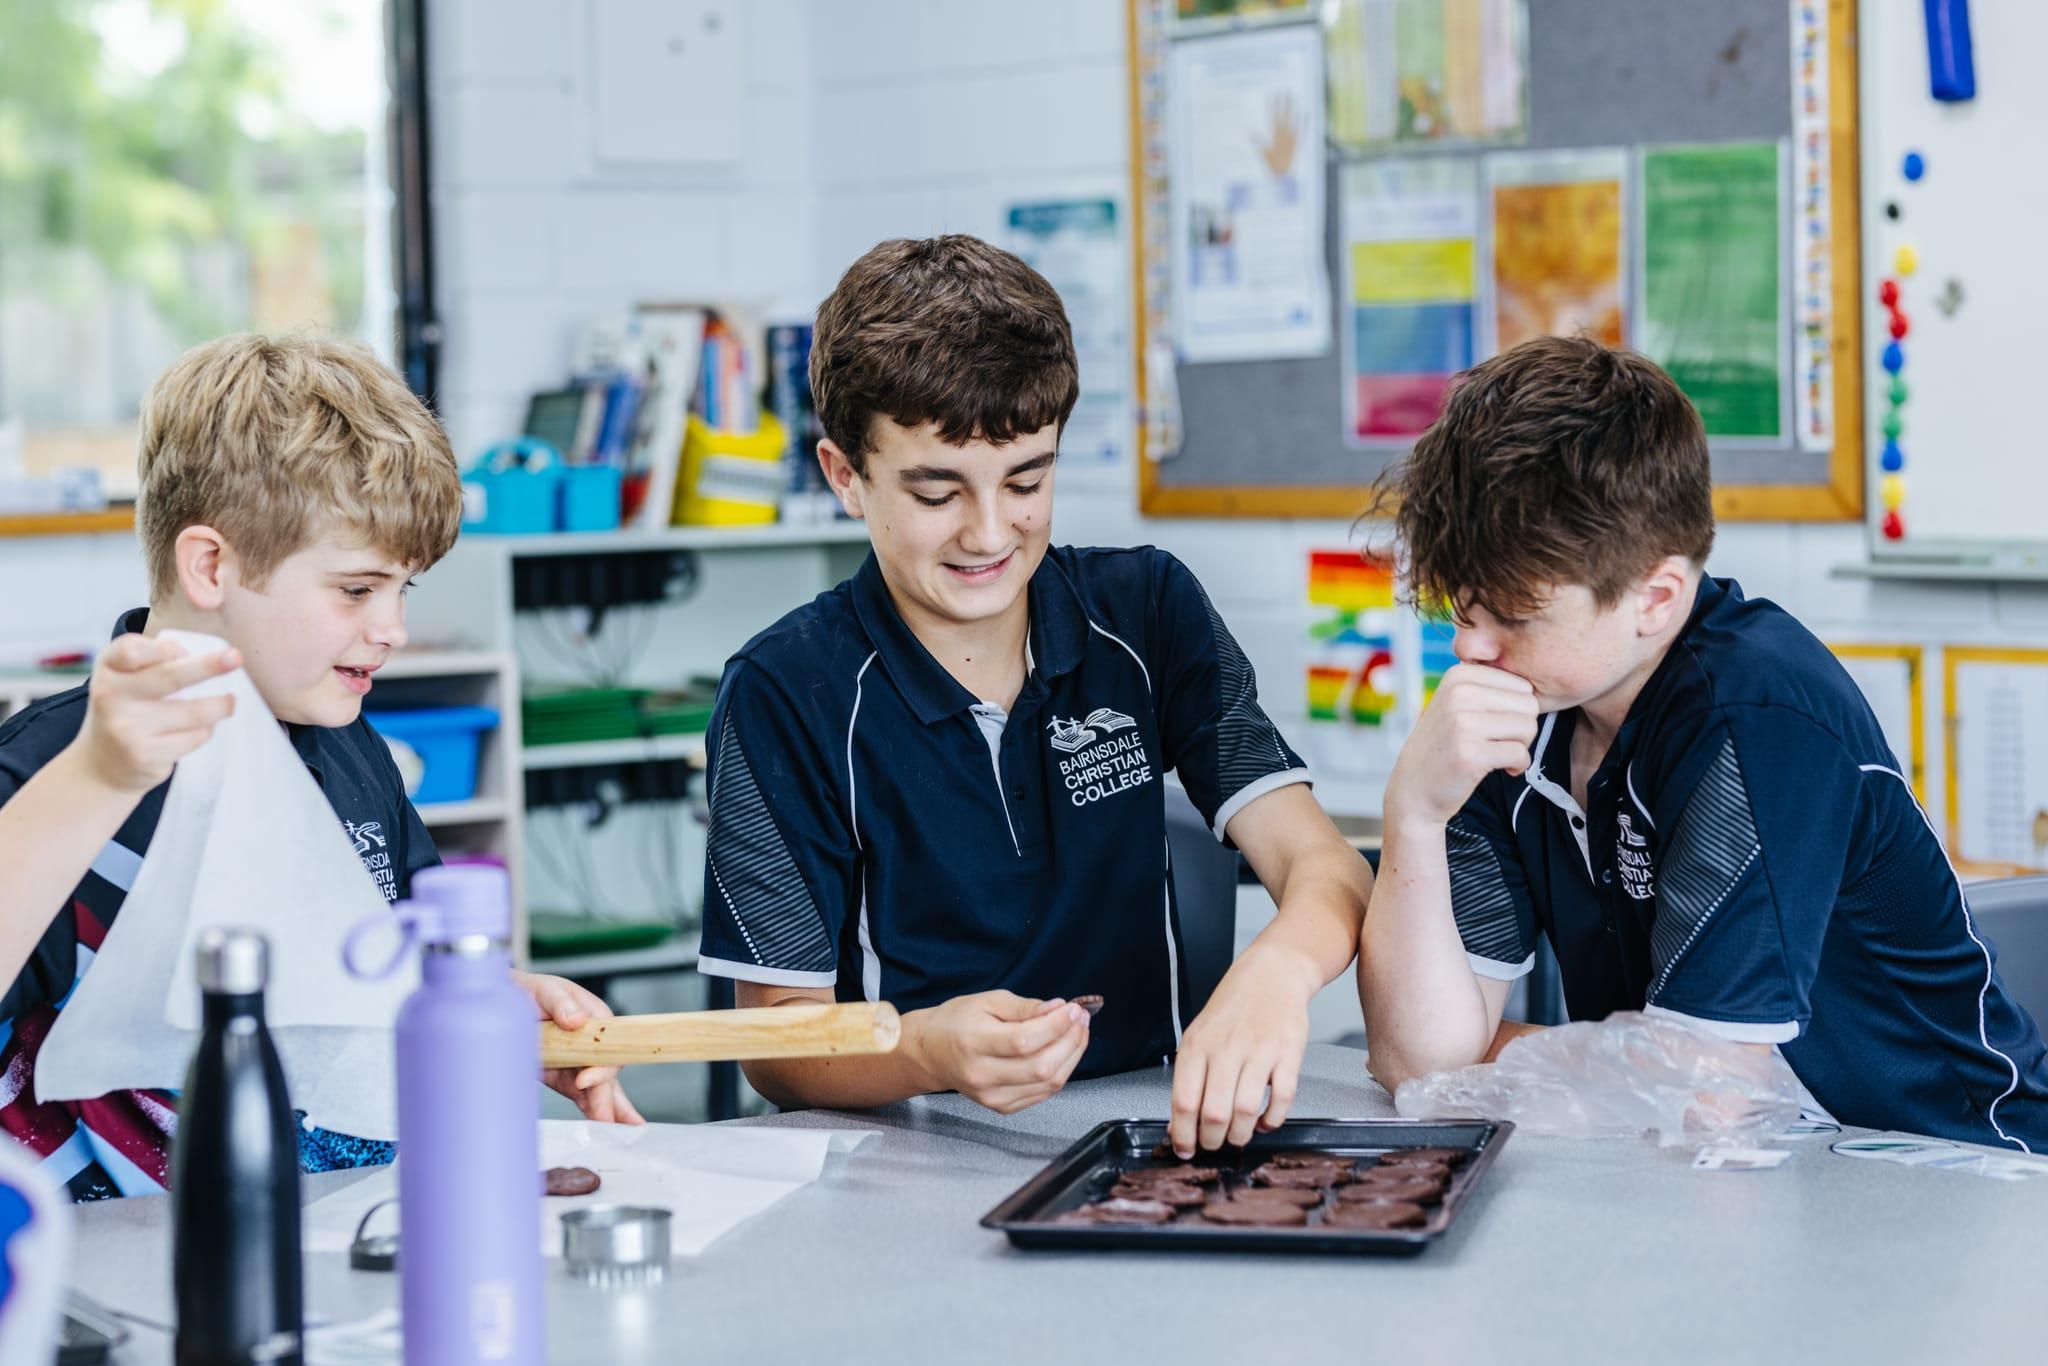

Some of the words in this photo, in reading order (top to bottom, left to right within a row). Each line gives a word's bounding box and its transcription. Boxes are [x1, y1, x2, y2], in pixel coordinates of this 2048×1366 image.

[1059, 731, 1142, 775] BAIRNSDALE
[1065, 747, 1147, 790] CHRISTIAN
[1071, 765, 1153, 807] COLLEGE
